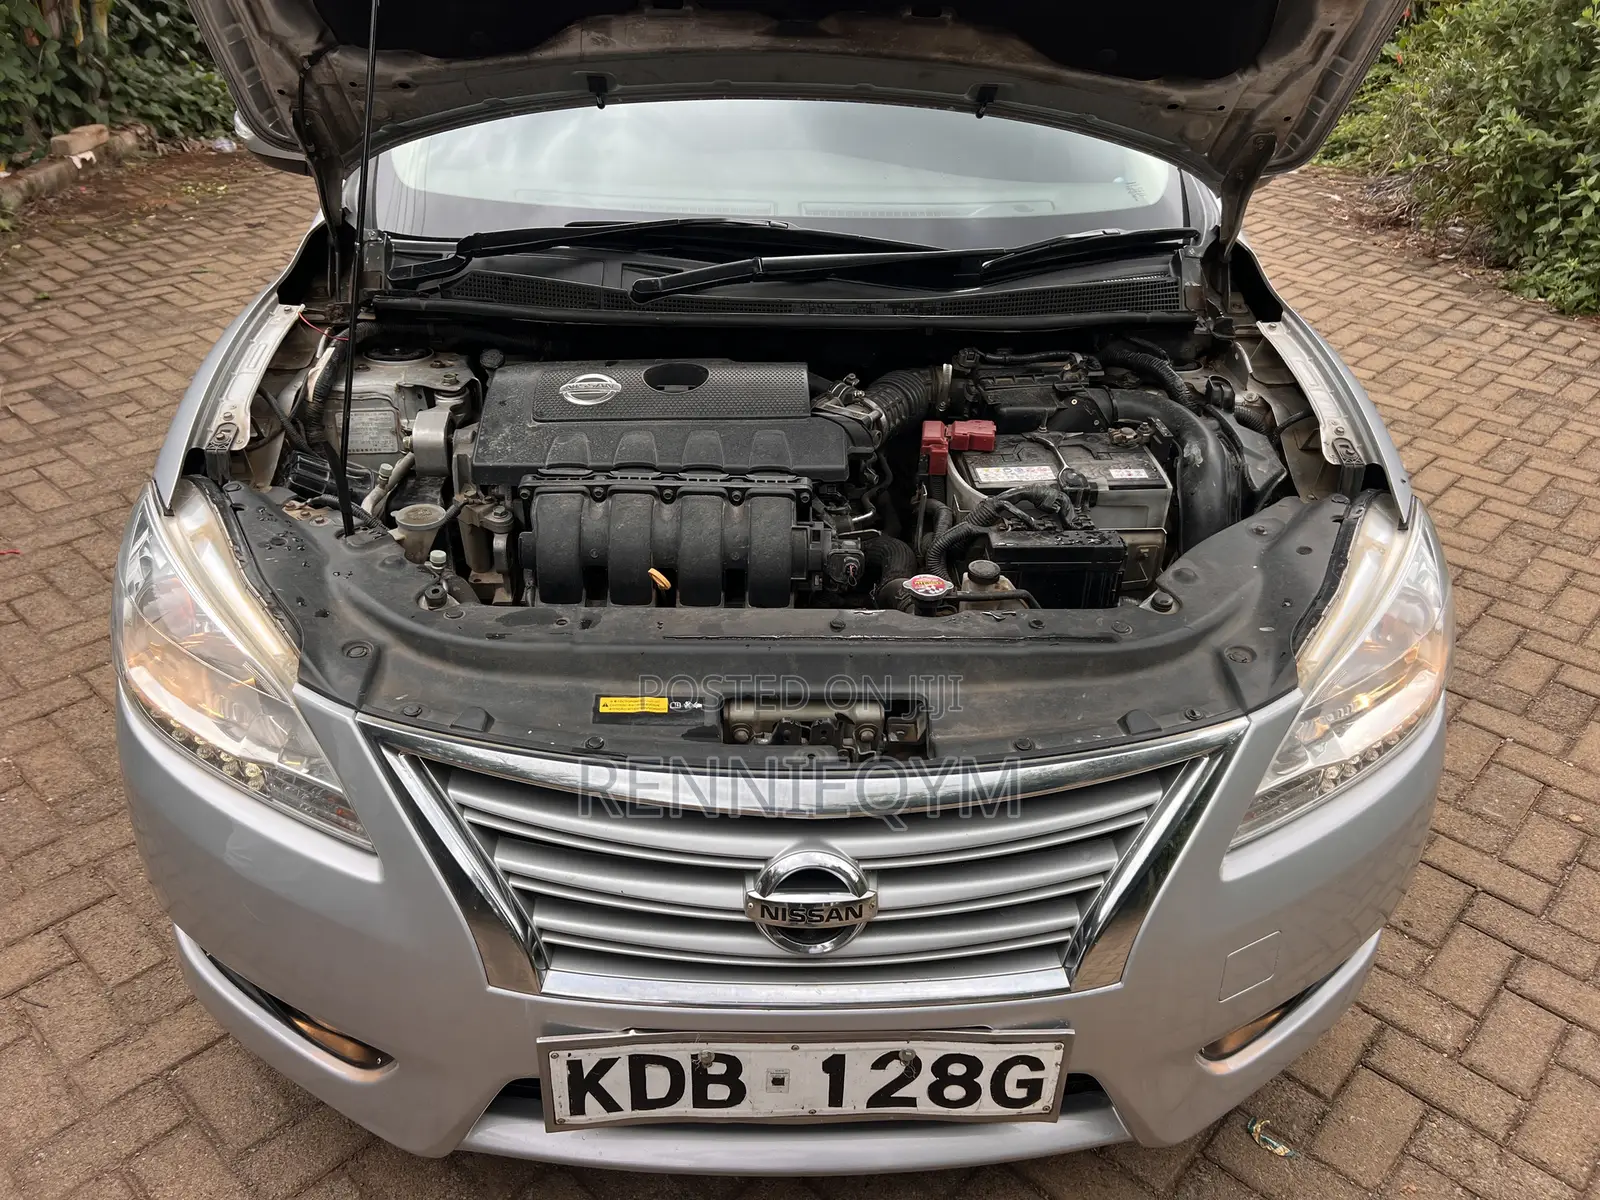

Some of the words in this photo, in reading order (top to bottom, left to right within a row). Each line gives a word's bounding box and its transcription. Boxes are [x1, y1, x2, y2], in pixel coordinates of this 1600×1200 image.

[565, 382, 614, 391] NISSAN
[760, 904, 863, 923] NISSAN
[565, 1053, 746, 1116] KDB
[821, 1052, 1046, 1110] 128G
